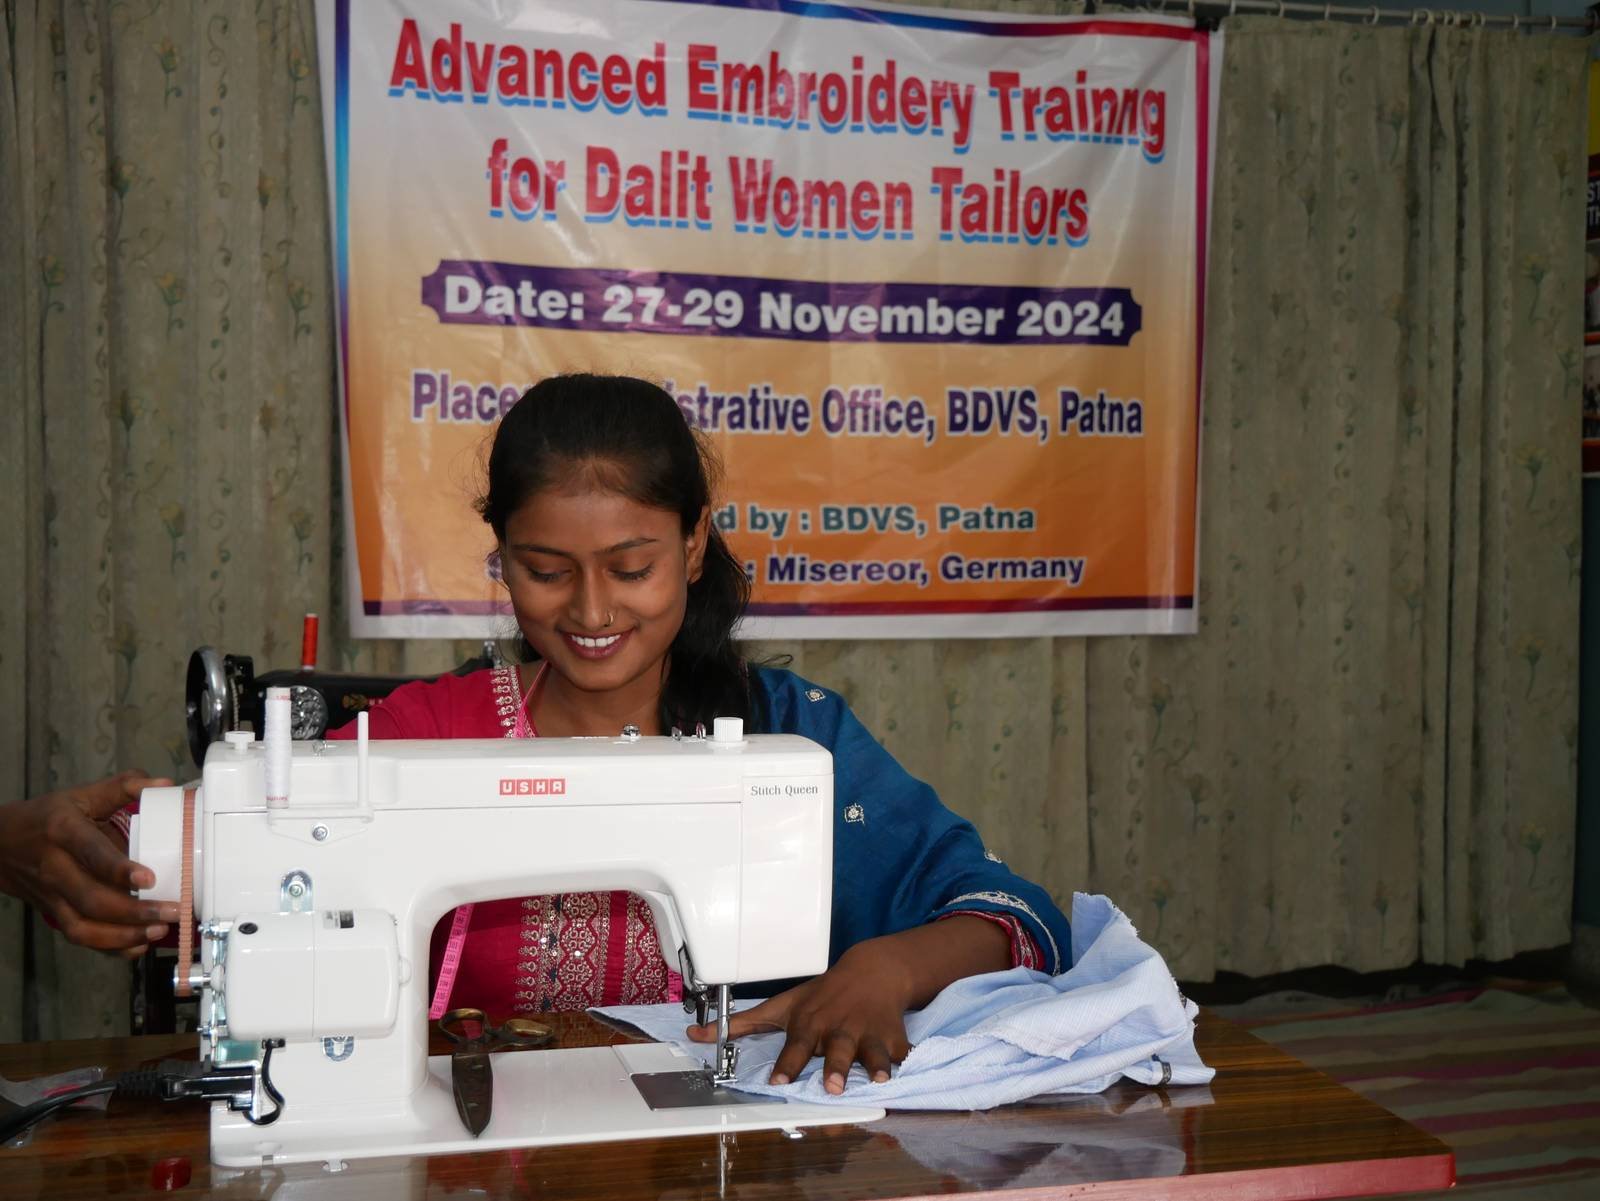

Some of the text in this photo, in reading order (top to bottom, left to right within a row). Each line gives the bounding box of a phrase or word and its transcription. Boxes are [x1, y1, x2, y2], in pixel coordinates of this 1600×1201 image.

[389, 18, 668, 116] Advanced
[687, 44, 975, 154] Embroidery
[487, 138, 1089, 248] for Dalit Women Tailors
[444, 275, 1125, 337] Date: 27-29 November 2024
[666, 381, 810, 433] strative
[821, 389, 935, 441] Office,
[947, 390, 1048, 442] BDVS,
[1060, 391, 1143, 434] Patna
[749, 505, 788, 537] by
[822, 506, 926, 535] BDVS,
[939, 506, 1034, 530] Patna
[768, 556, 928, 584] Misereor,
[941, 555, 1084, 584] Germany
[501, 779, 564, 794] USHA
[751, 784, 818, 796] Stitch Queen
